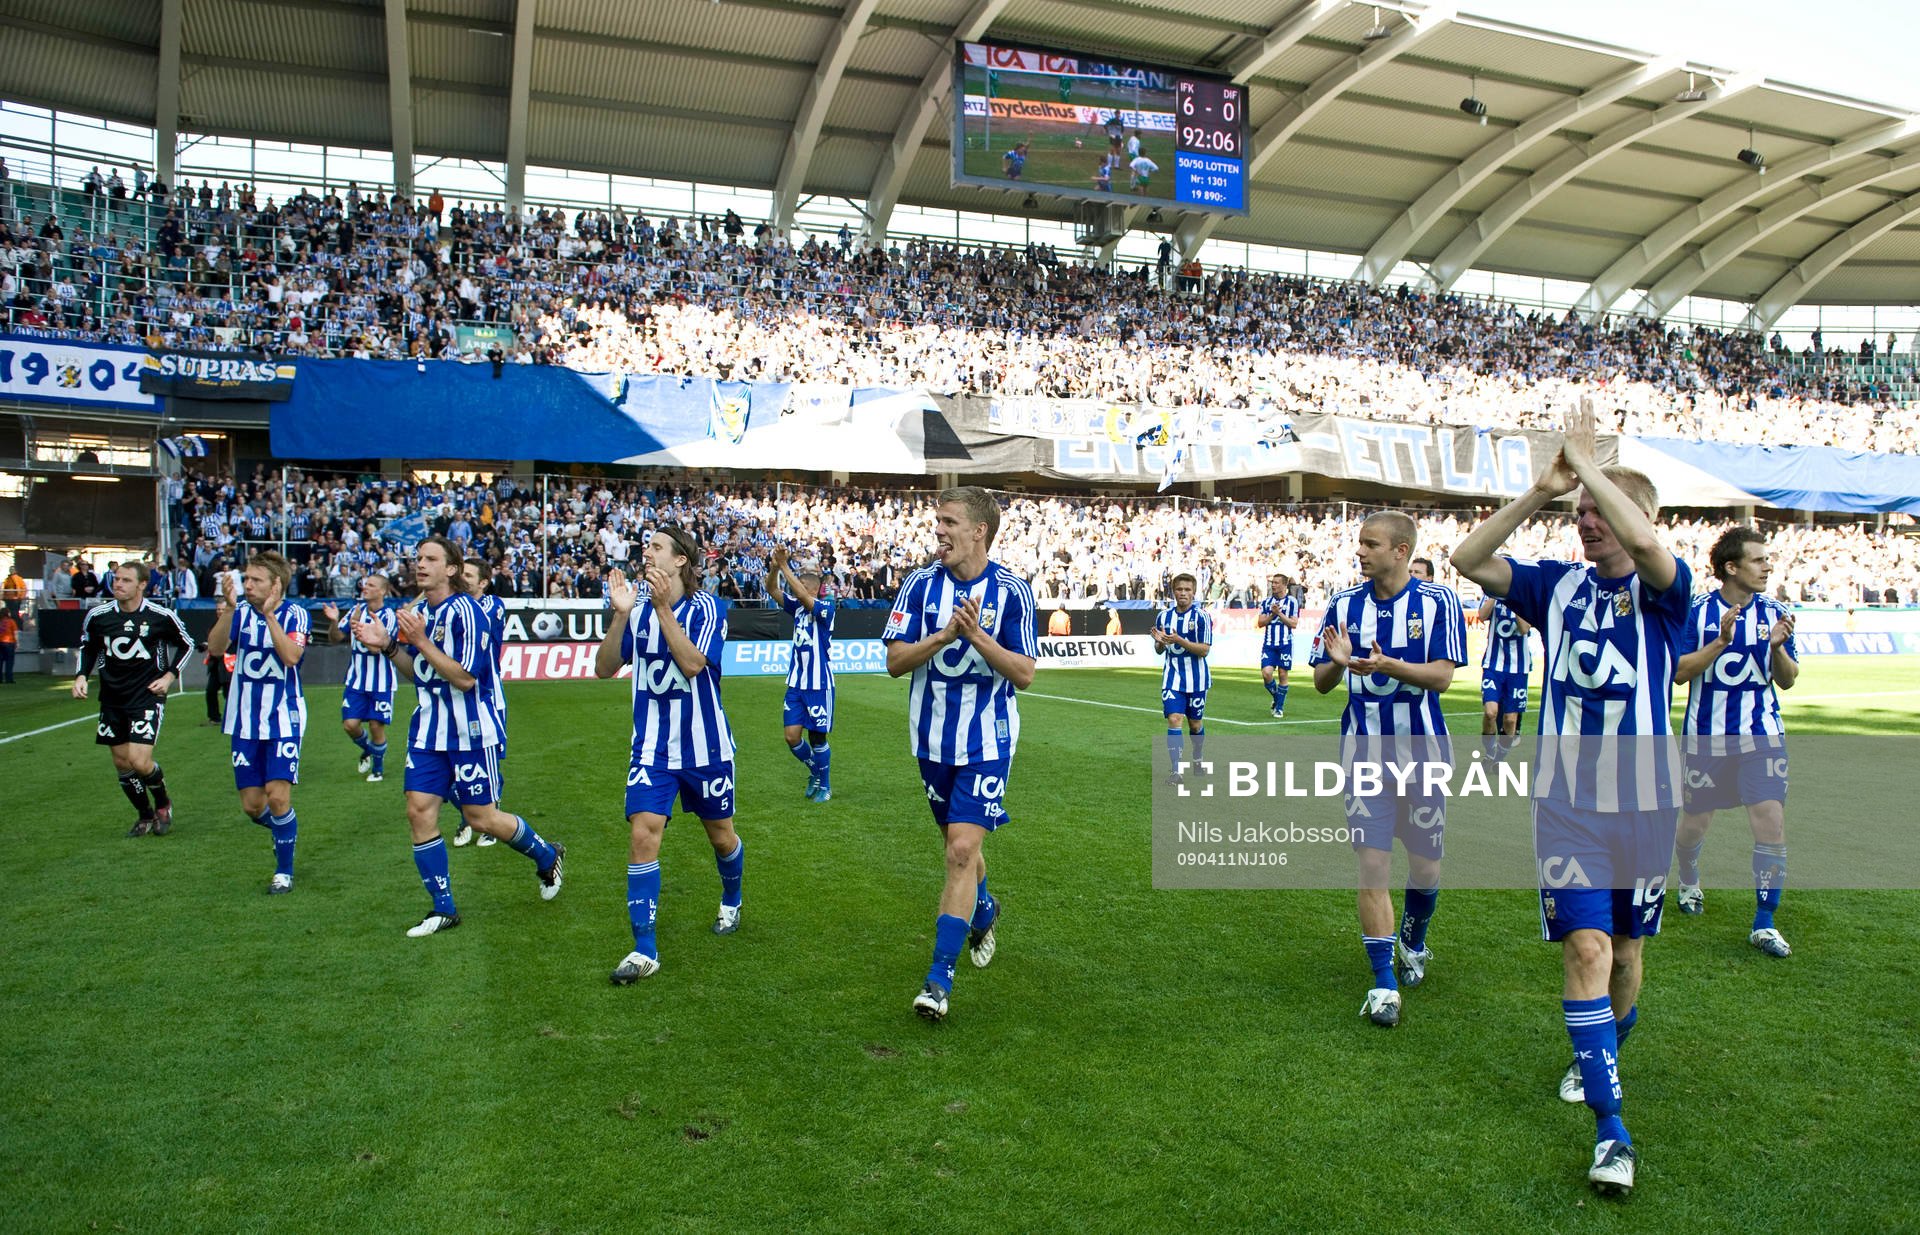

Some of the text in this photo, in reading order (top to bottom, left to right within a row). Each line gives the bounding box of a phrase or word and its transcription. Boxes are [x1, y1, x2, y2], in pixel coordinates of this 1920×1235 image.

[986, 45, 1026, 70] ICA
[1180, 82, 1194, 93] IFK
[1223, 89, 1237, 99] DIF
[990, 101, 1076, 119] nyckelhus
[1183, 96, 1194, 116] 6
[1223, 102, 1234, 121] 0
[1183, 127, 1235, 151] 92:06
[1178, 157, 1239, 174] 50/50 LOTTEN
[1191, 174, 1227, 187] Nr: 1301
[1191, 190, 1227, 202] 19 890:-
[160, 354, 277, 381] SUPRAS
[1335, 416, 1433, 487] ETT
[1436, 427, 1535, 496] LAG
[955, 589, 968, 598] ICA
[1597, 589, 1614, 600] ICA
[1378, 610, 1393, 618] ICA
[103, 636, 152, 660] ICA
[238, 649, 285, 680] ICA
[1553, 630, 1638, 689] ICA
[1704, 651, 1768, 686] ICA
[807, 704, 827, 718] ICA
[1189, 697, 1205, 708] ICA
[130, 720, 155, 736] ICA
[816, 718, 827, 727] 22
[289, 761, 296, 773] 6
[454, 762, 489, 782] ICA
[972, 773, 1006, 799] ICA
[1684, 766, 1716, 789] ICA
[468, 783, 483, 797] 13
[702, 775, 734, 799] ICA
[721, 797, 729, 811] 5
[983, 801, 999, 817] 19
[1408, 804, 1445, 829] ICA
[1429, 831, 1443, 847] 11
[1538, 855, 1593, 888] ICA
[1602, 1048, 1623, 1100] SKF
